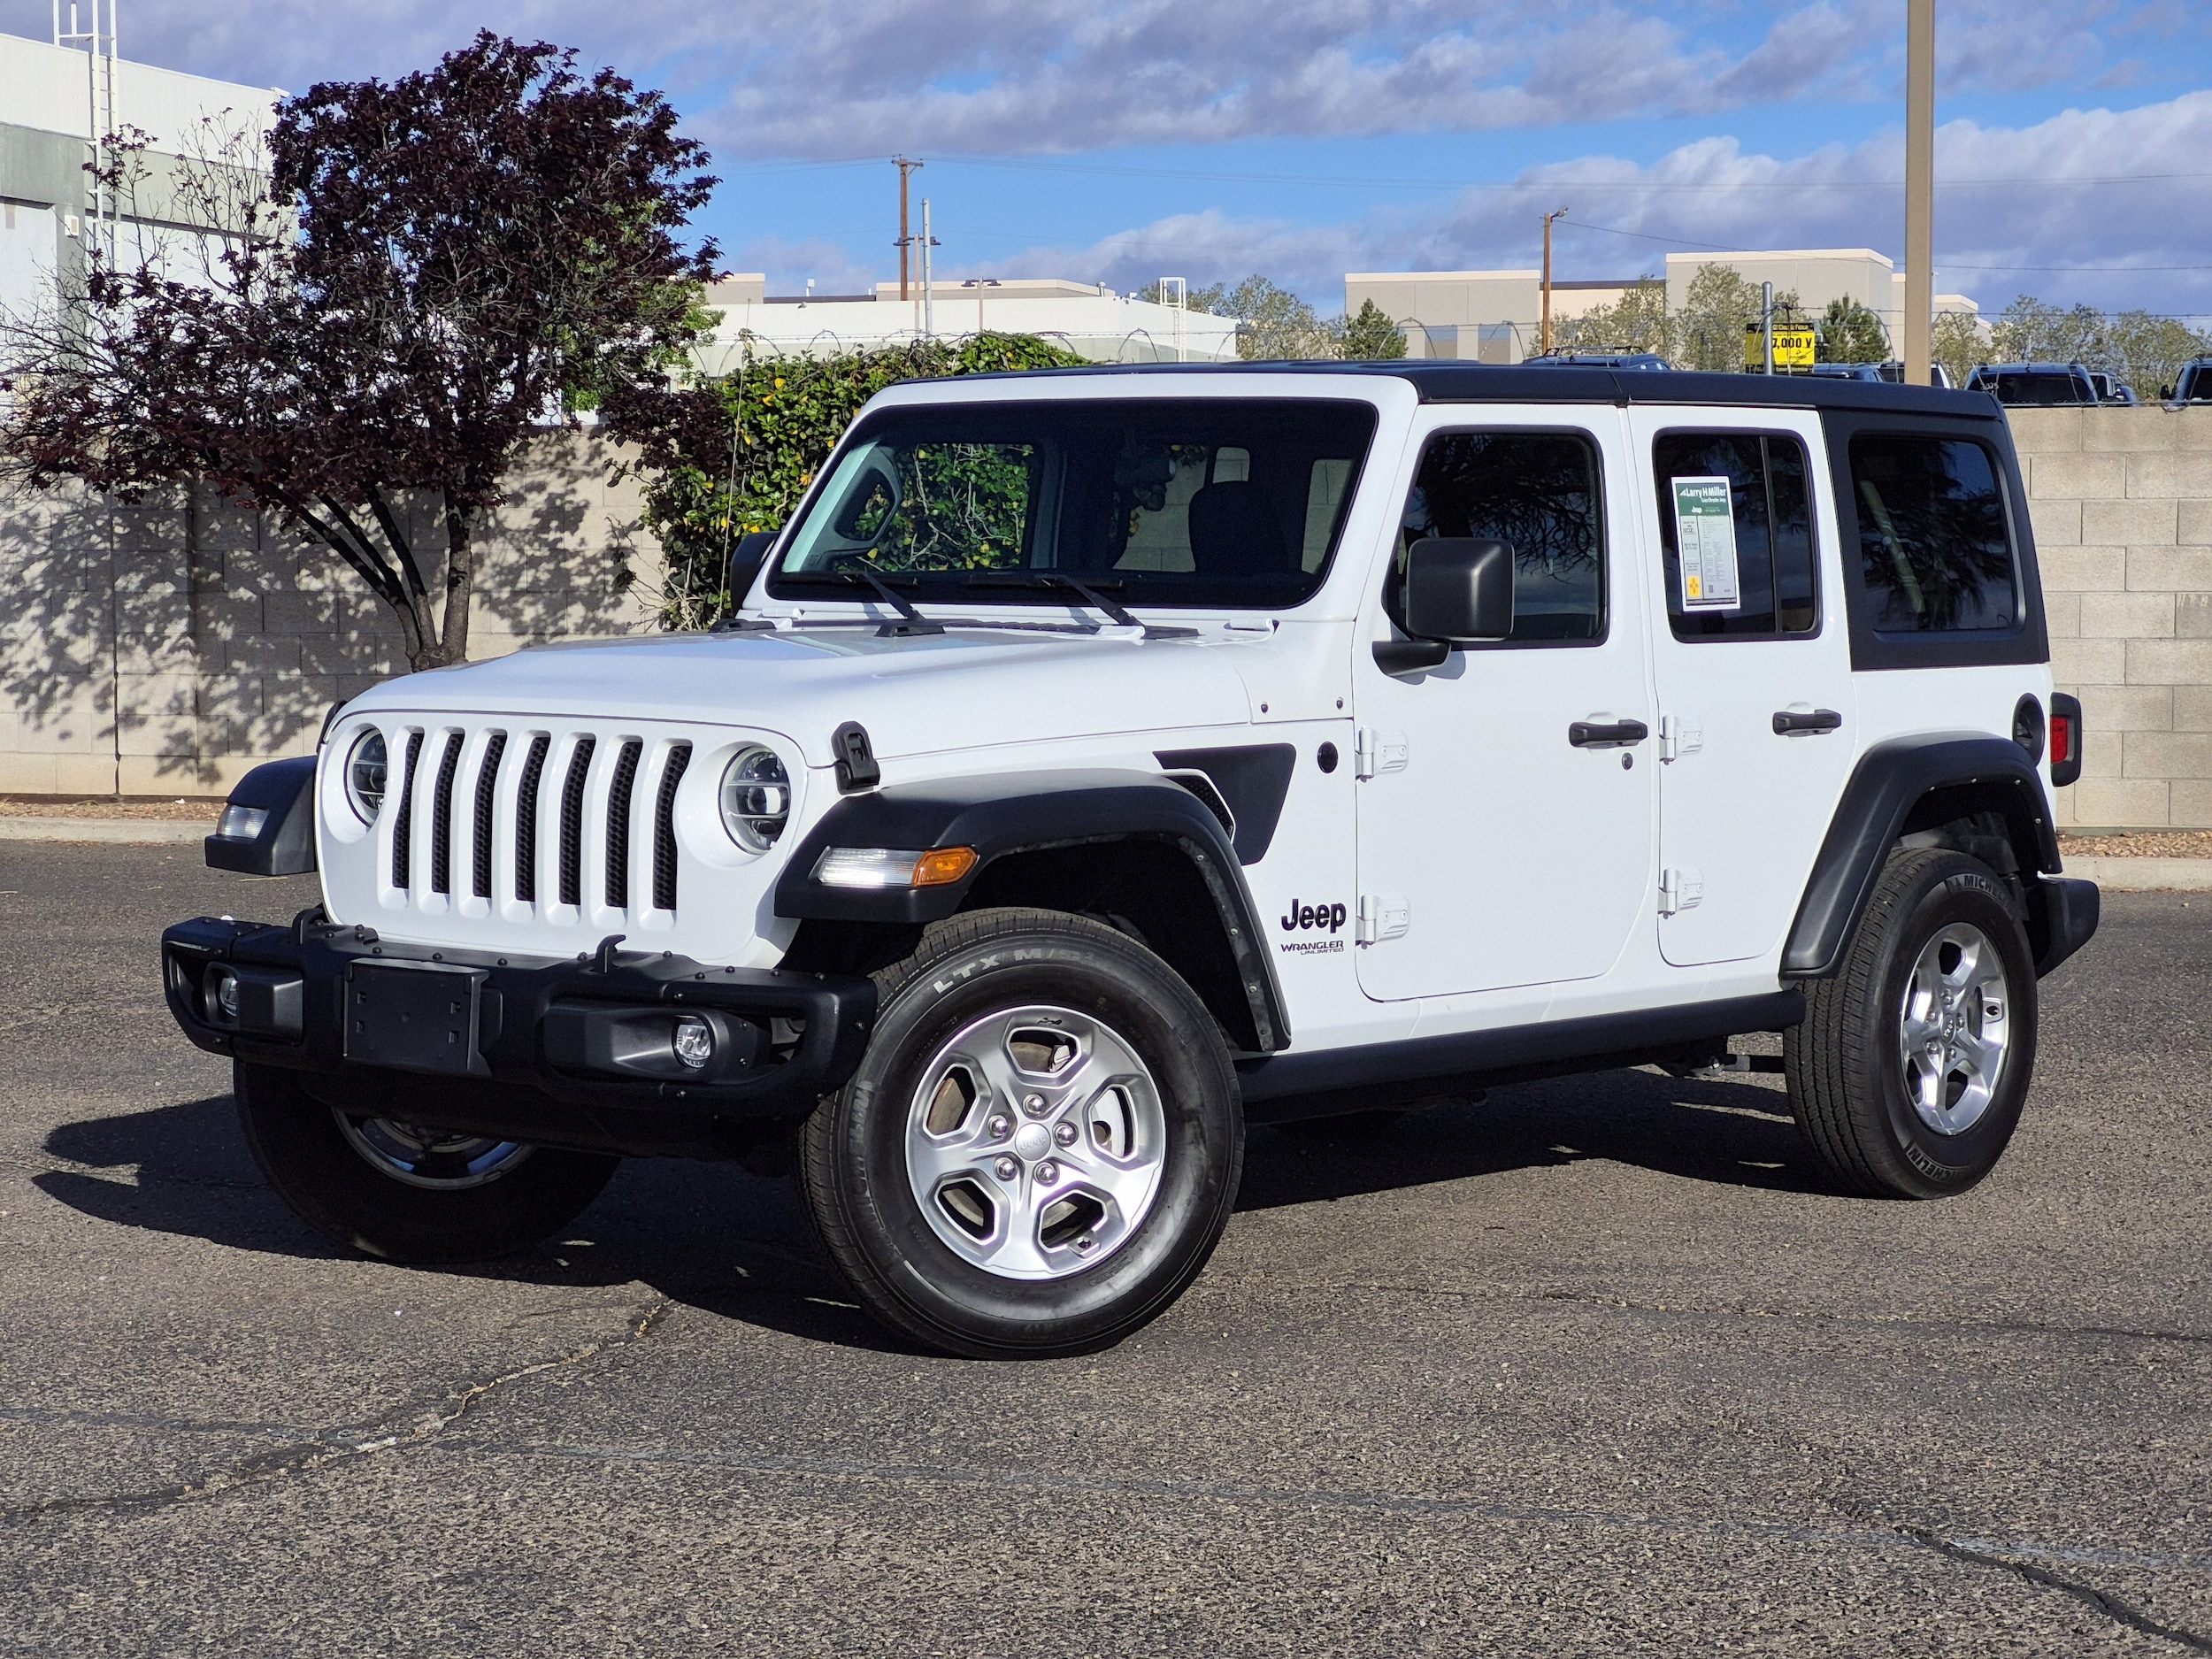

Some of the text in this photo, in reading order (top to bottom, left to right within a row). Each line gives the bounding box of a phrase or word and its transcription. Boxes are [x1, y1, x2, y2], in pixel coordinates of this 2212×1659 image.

[1772, 337, 1812, 349] 7,000 V
[1685, 486, 1726, 499] Larry H Miller
[1280, 898, 1347, 933] Jeep
[1280, 940, 1344, 952] WRANGLER
[933, 954, 1000, 994] LTX
[1020, 1134, 1048, 1150] Jeep
[1908, 1148, 1965, 1182] ICHELIN
